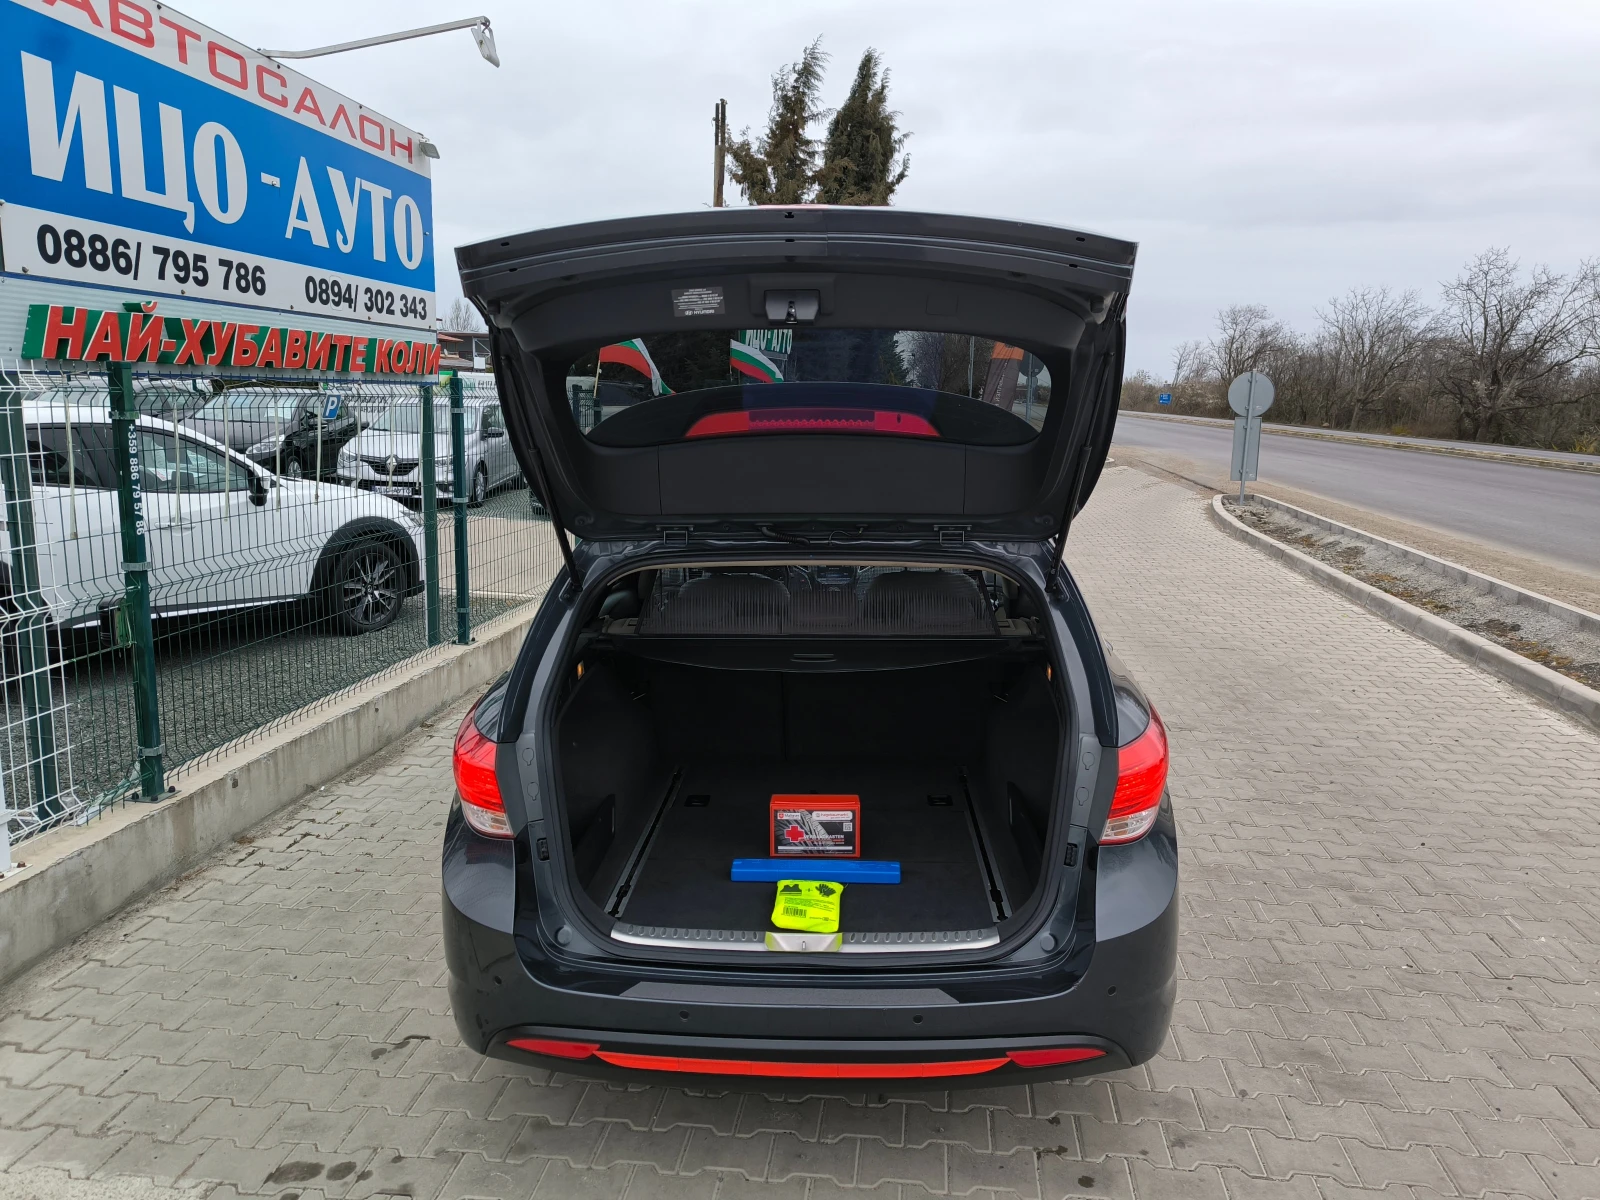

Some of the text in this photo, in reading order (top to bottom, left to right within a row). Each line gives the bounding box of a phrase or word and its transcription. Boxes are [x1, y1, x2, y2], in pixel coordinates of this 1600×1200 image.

[36, 223, 427, 320] 0886/ 795 786 0894/ 302 343
[42, 300, 441, 375] НАЙ-ХУБАВИТЕ КОЛИ
[127, 423, 145, 535] +359 886 79 57 86
